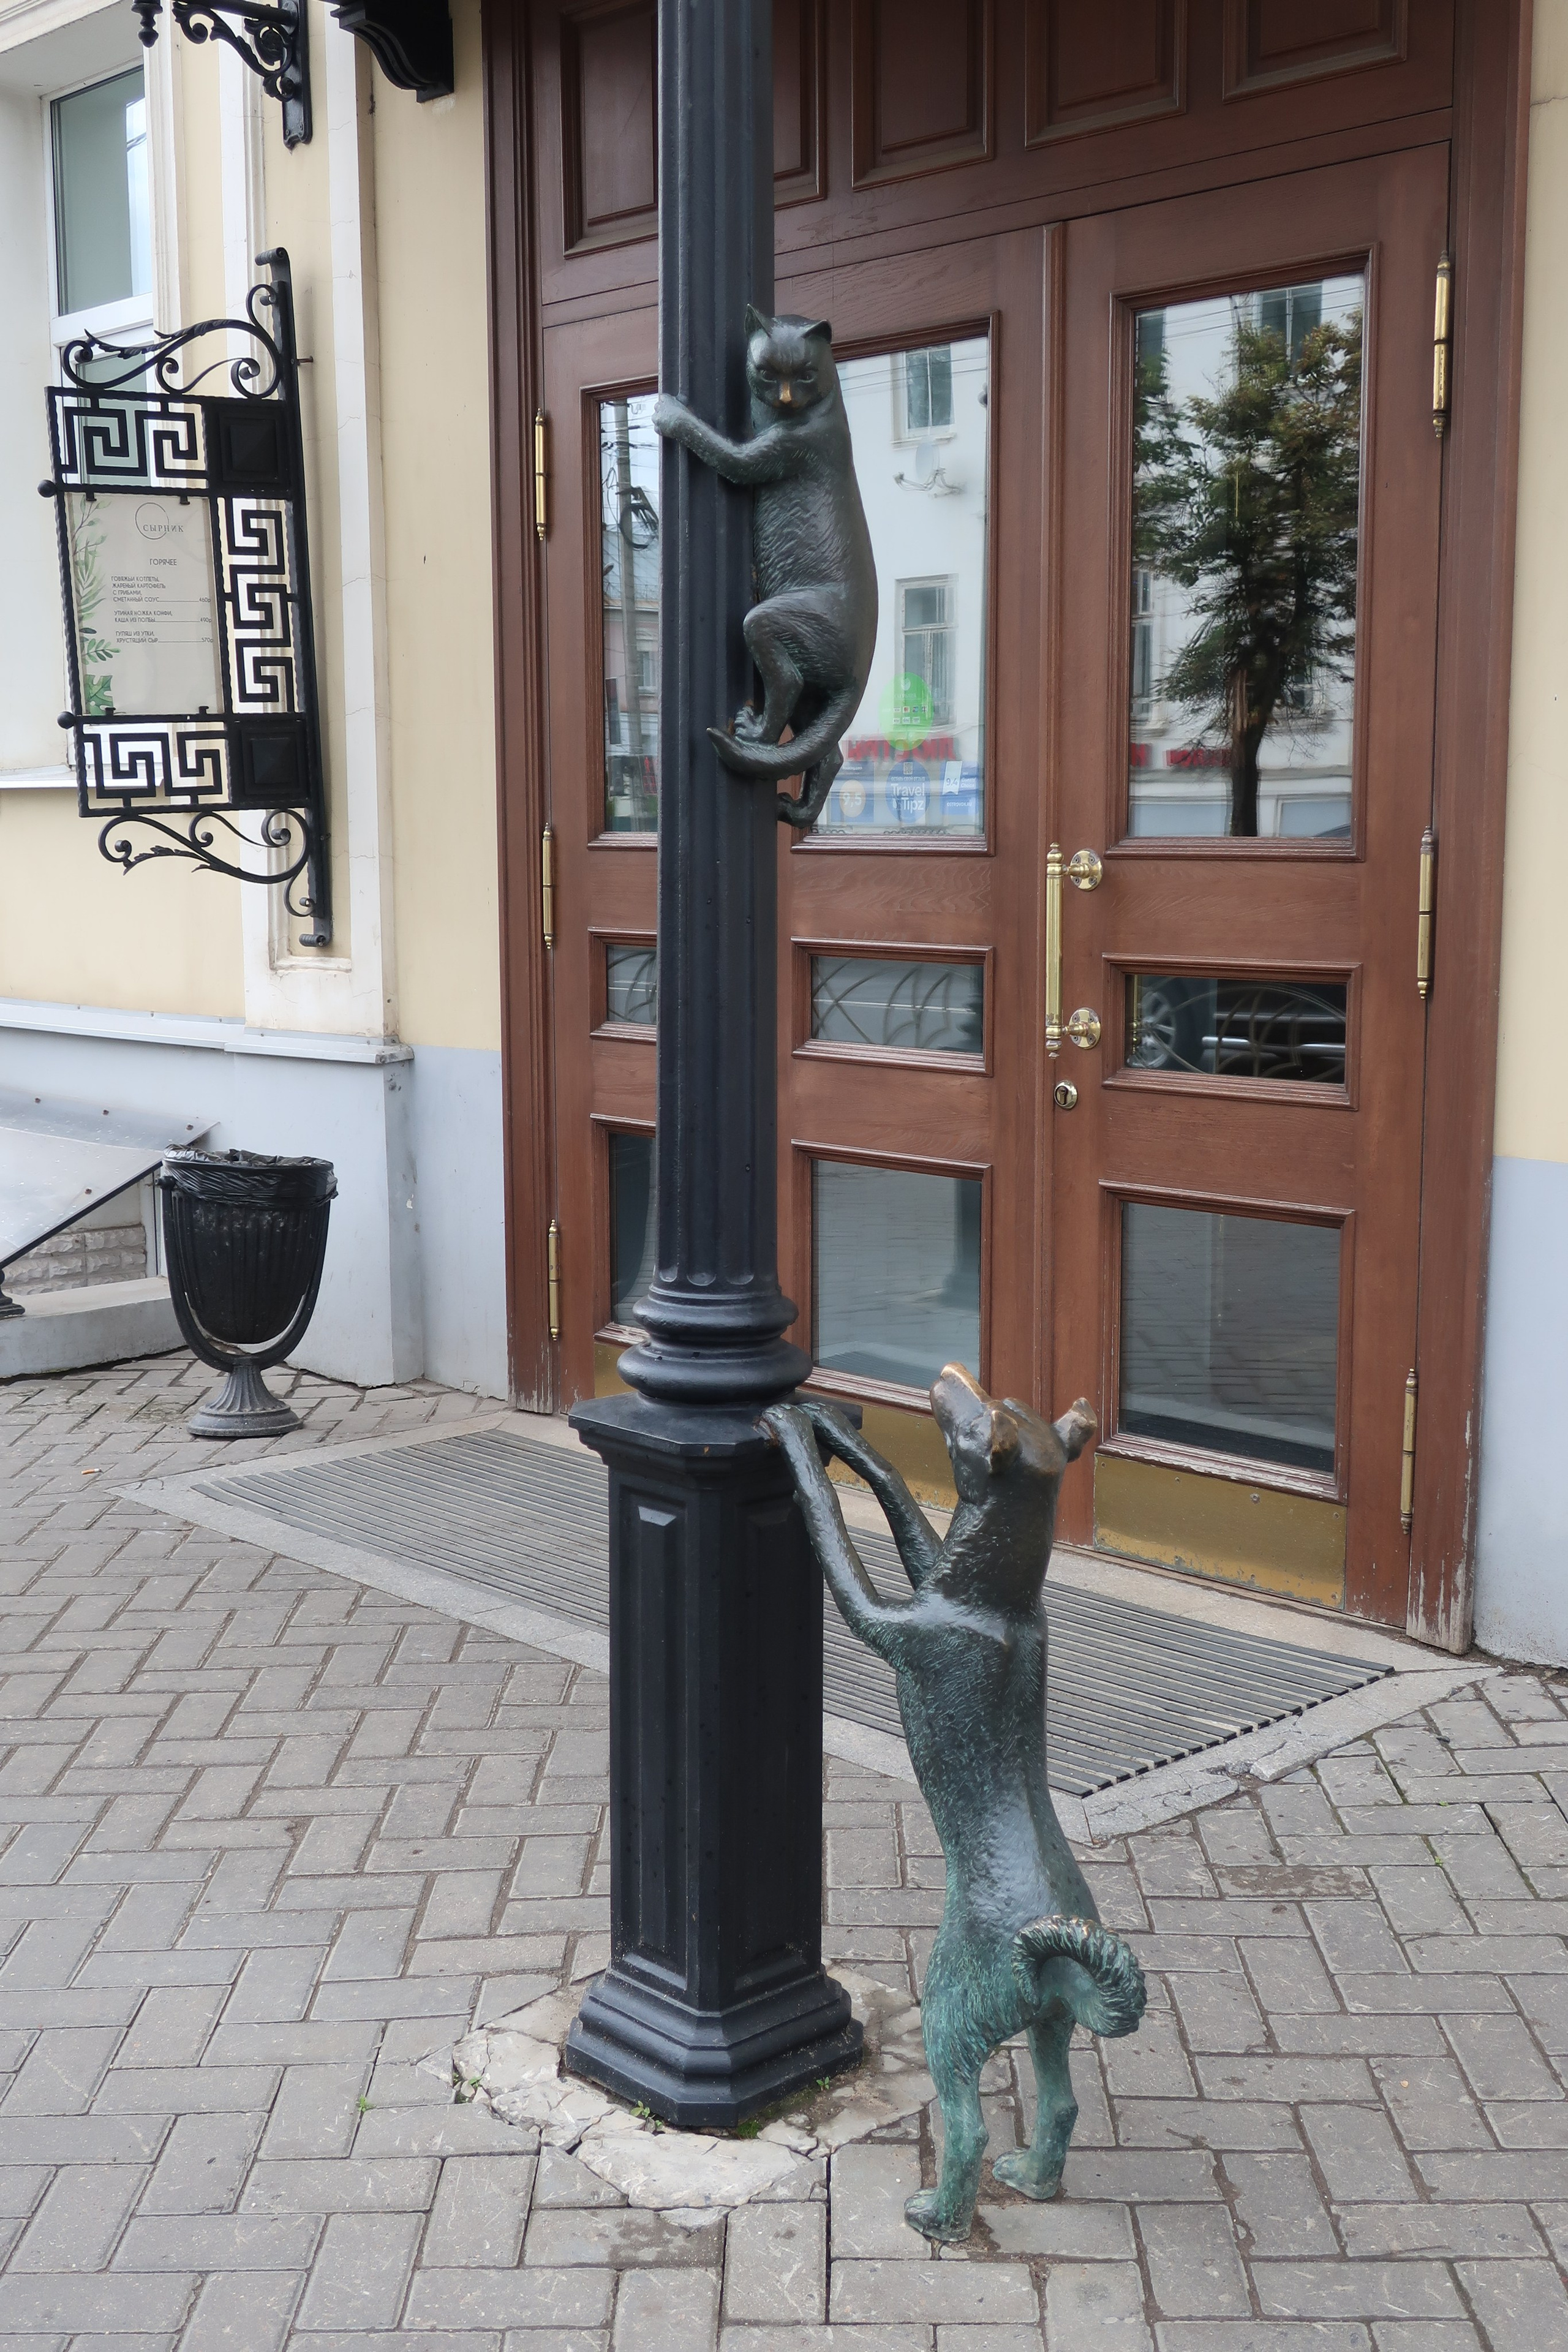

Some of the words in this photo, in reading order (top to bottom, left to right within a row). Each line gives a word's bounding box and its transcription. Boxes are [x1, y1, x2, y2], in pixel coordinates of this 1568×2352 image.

[143, 524, 184, 532] СЫРНИК
[891, 782, 925, 796] Travel
[843, 793, 862, 808] 9,5
[901, 797, 924, 813] Tipz
